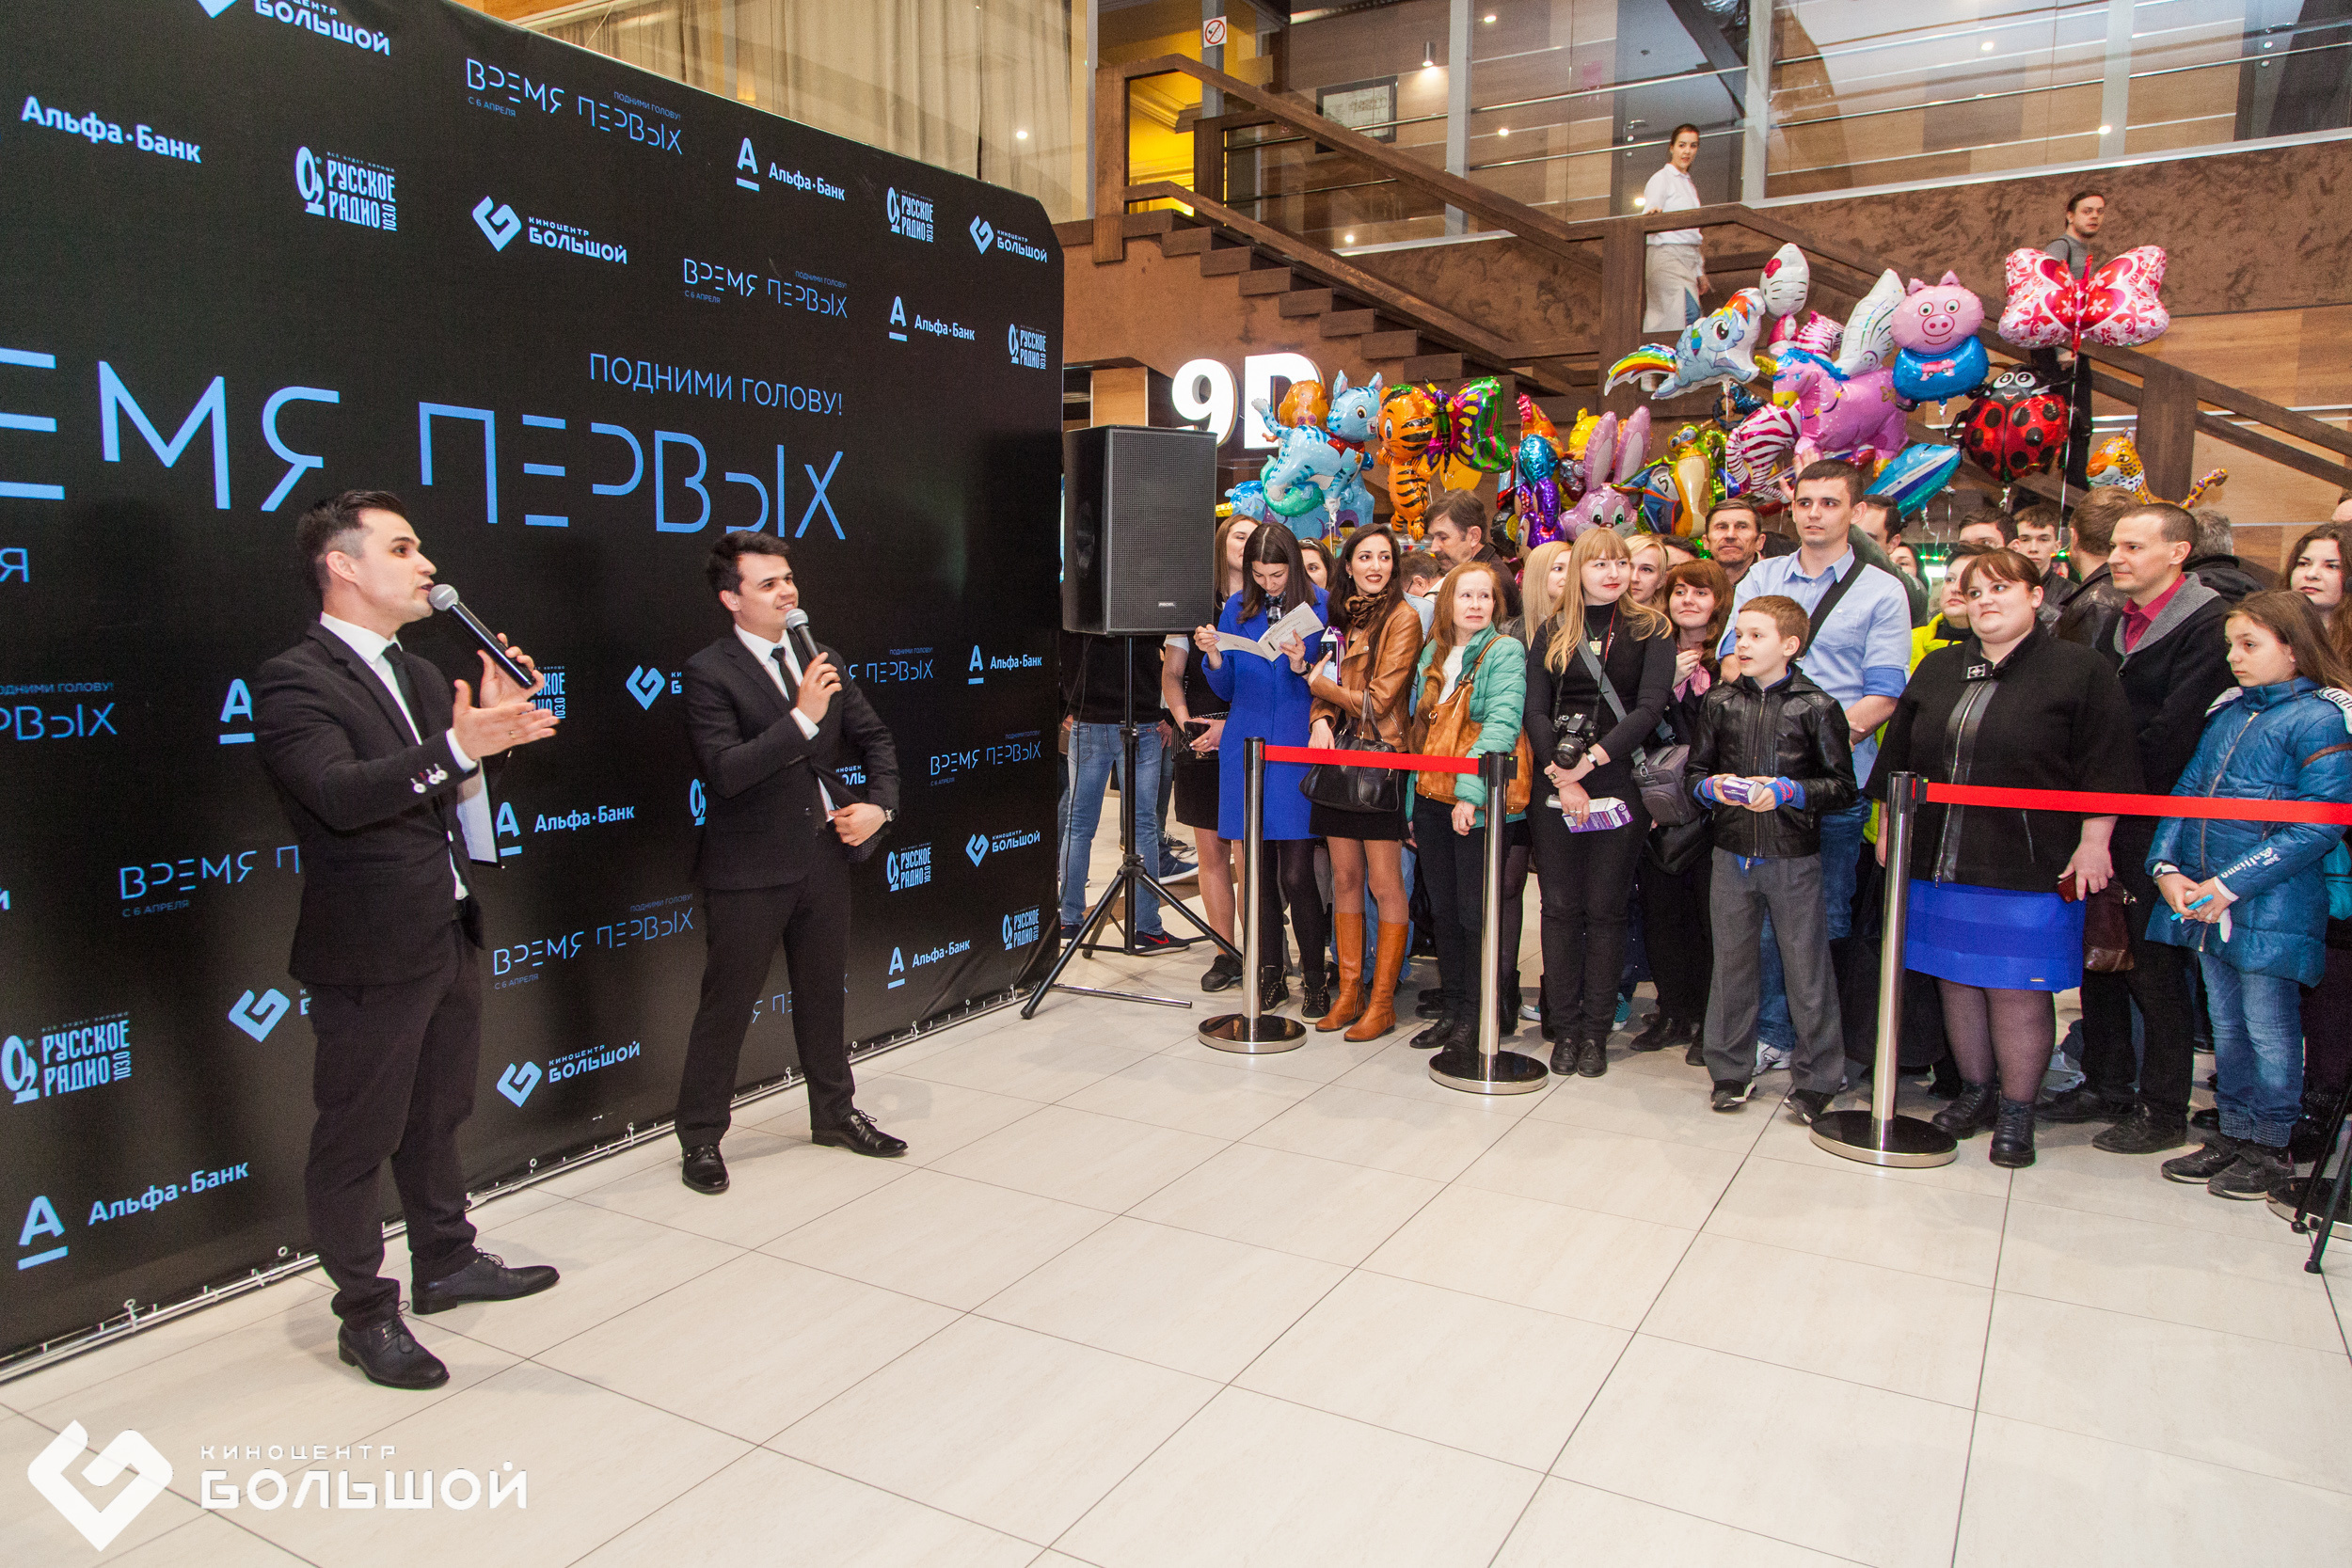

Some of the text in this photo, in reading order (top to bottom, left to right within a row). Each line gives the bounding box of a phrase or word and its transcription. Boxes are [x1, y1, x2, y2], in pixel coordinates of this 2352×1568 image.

[255, 0, 389, 55] БОЛЬШОЙ
[476, 99, 482, 107] 6
[483, 101, 516, 117] АПРЕЛЯ
[613, 91, 681, 121] ПОДНИМИ ГОЛОВУ!
[326, 159, 396, 203] РУССКОЕ
[328, 190, 381, 229] РАДИО
[381, 203, 397, 231] 103.0
[901, 195, 934, 224] РУССКОЕ
[528, 216, 590, 237] КИНОЦЕНТР
[901, 215, 926, 241] РАДИО
[997, 229, 1028, 243] КИНОЦЕНТР
[528, 226, 628, 264] БОЛЬШОЙ
[997, 236, 1048, 263] БОЛЬШОЙ
[795, 270, 824, 284] ПОДНИМИ
[695, 293, 721, 304] АПРЕЛЯ
[1020, 329, 1046, 353] РУССКОЕ
[1020, 348, 1040, 369] РАДИО
[589, 353, 843, 416] ПОДНИМИ ГОЛОВУ!
[0, 347, 340, 512] ЕМЯ
[57, 681, 114, 692] ГОЛОВУ!
[835, 765, 862, 773] ИНОЦЕН
[992, 830, 1023, 840] КИНОЦЕНТР
[992, 830, 1041, 853] БОЛЬШОЙ
[900, 847, 931, 870] РУССКОЕ
[2220, 847, 2273, 879] Galliano
[900, 867, 924, 889] РАДИО
[133, 907, 141, 916] 6
[143, 899, 189, 914] АПРЕЛЯ
[629, 899, 664, 912] ПОДНИМИ
[1013, 908, 1040, 931] РУССКОЕ
[1013, 927, 1033, 948] РАДИО
[508, 973, 539, 987] АПРЕЛЯ
[41, 1019, 131, 1065] РУССКОЕ
[112, 1051, 132, 1082] 103.0
[548, 1044, 605, 1067] КИНОЦЕНТР
[548, 1040, 641, 1084] БОЛЬШОЙ
[43, 1055, 111, 1097] РАДИО
